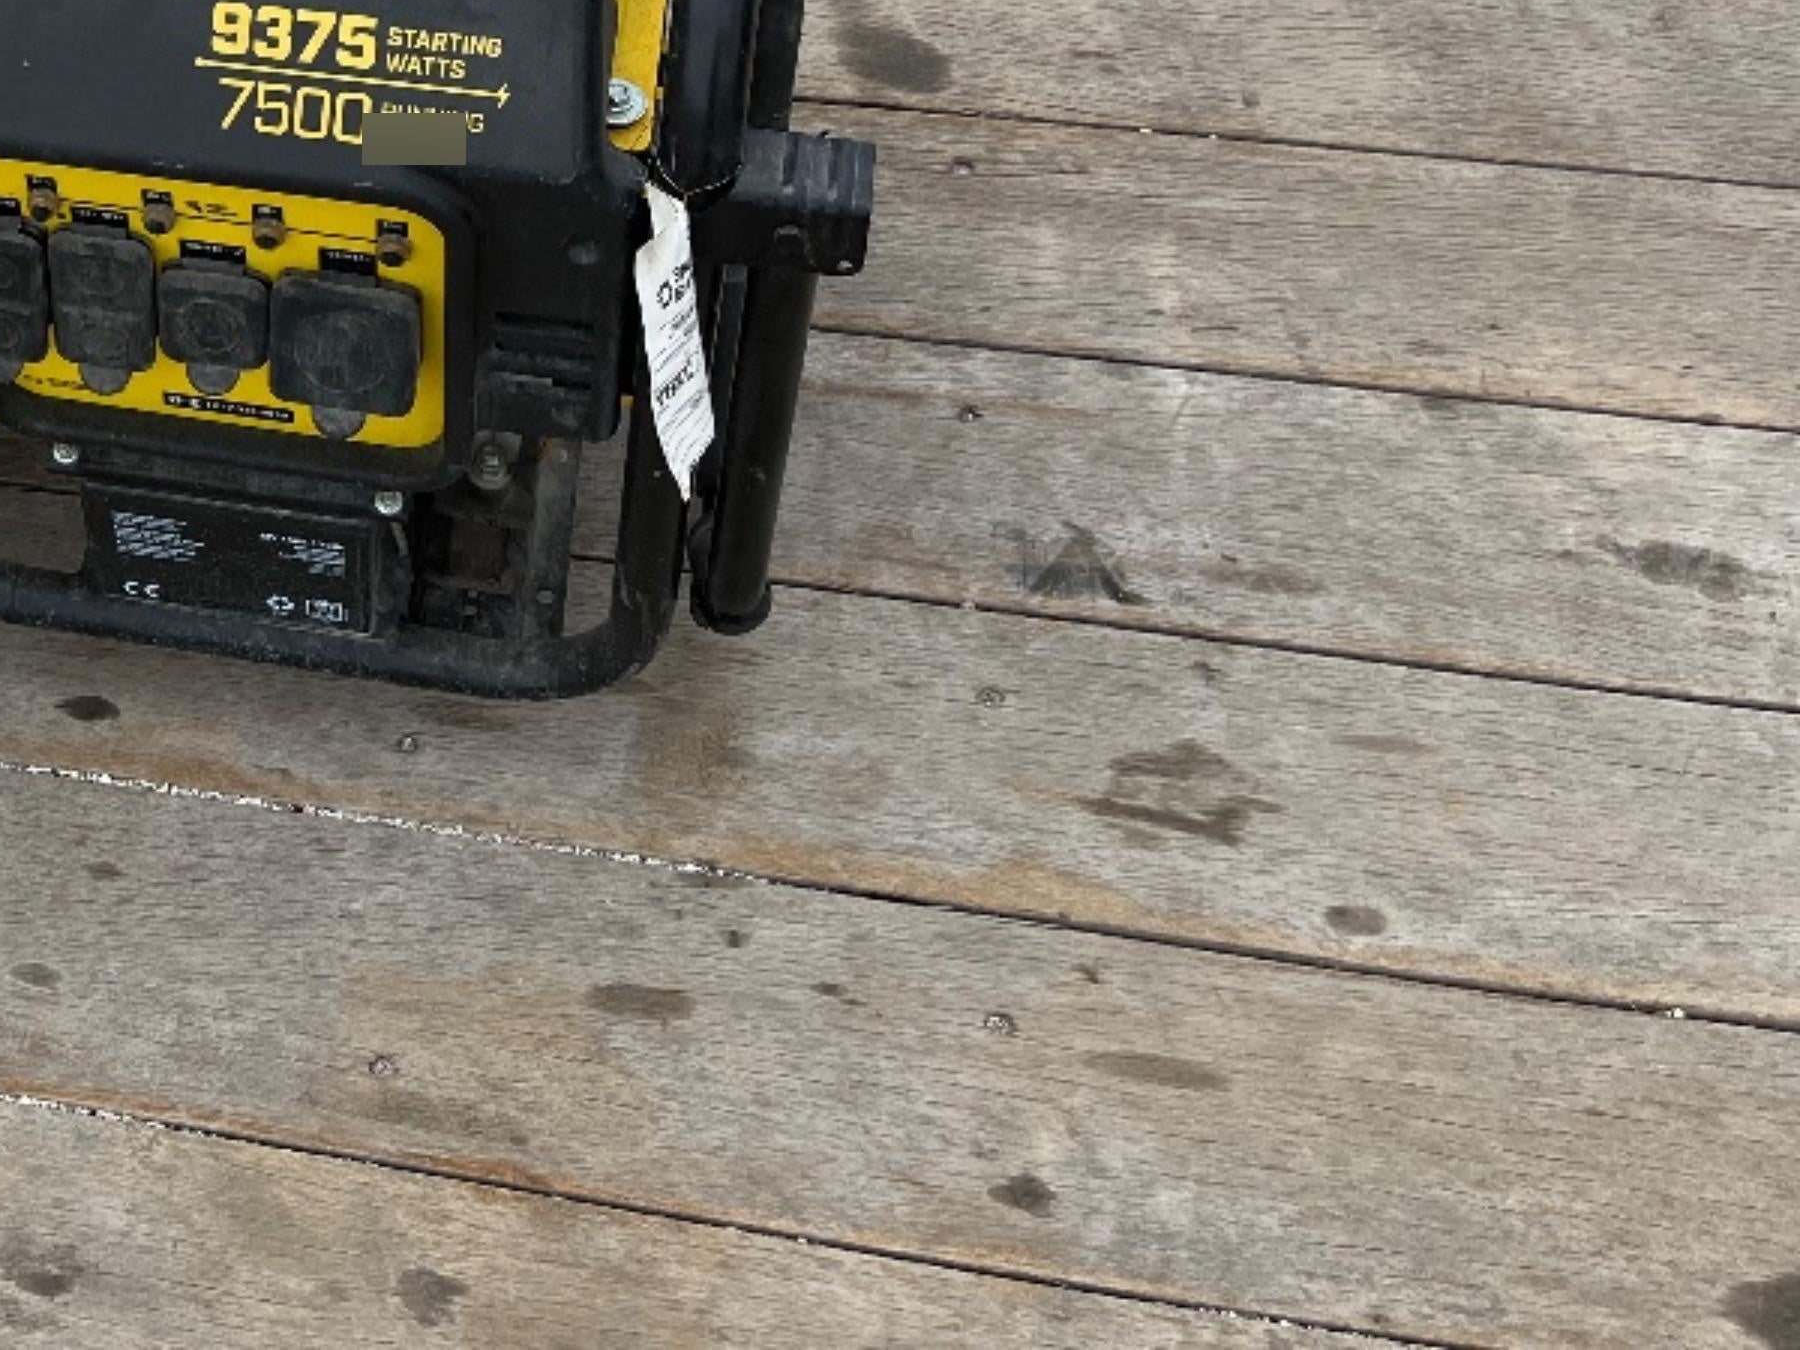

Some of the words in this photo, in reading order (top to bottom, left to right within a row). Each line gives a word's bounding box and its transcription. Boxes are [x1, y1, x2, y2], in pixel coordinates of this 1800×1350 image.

[211, 0, 379, 71] 9375
[385, 25, 503, 59] STARTING
[385, 52, 467, 80] WATTS
[218, 77, 373, 146] 7500
